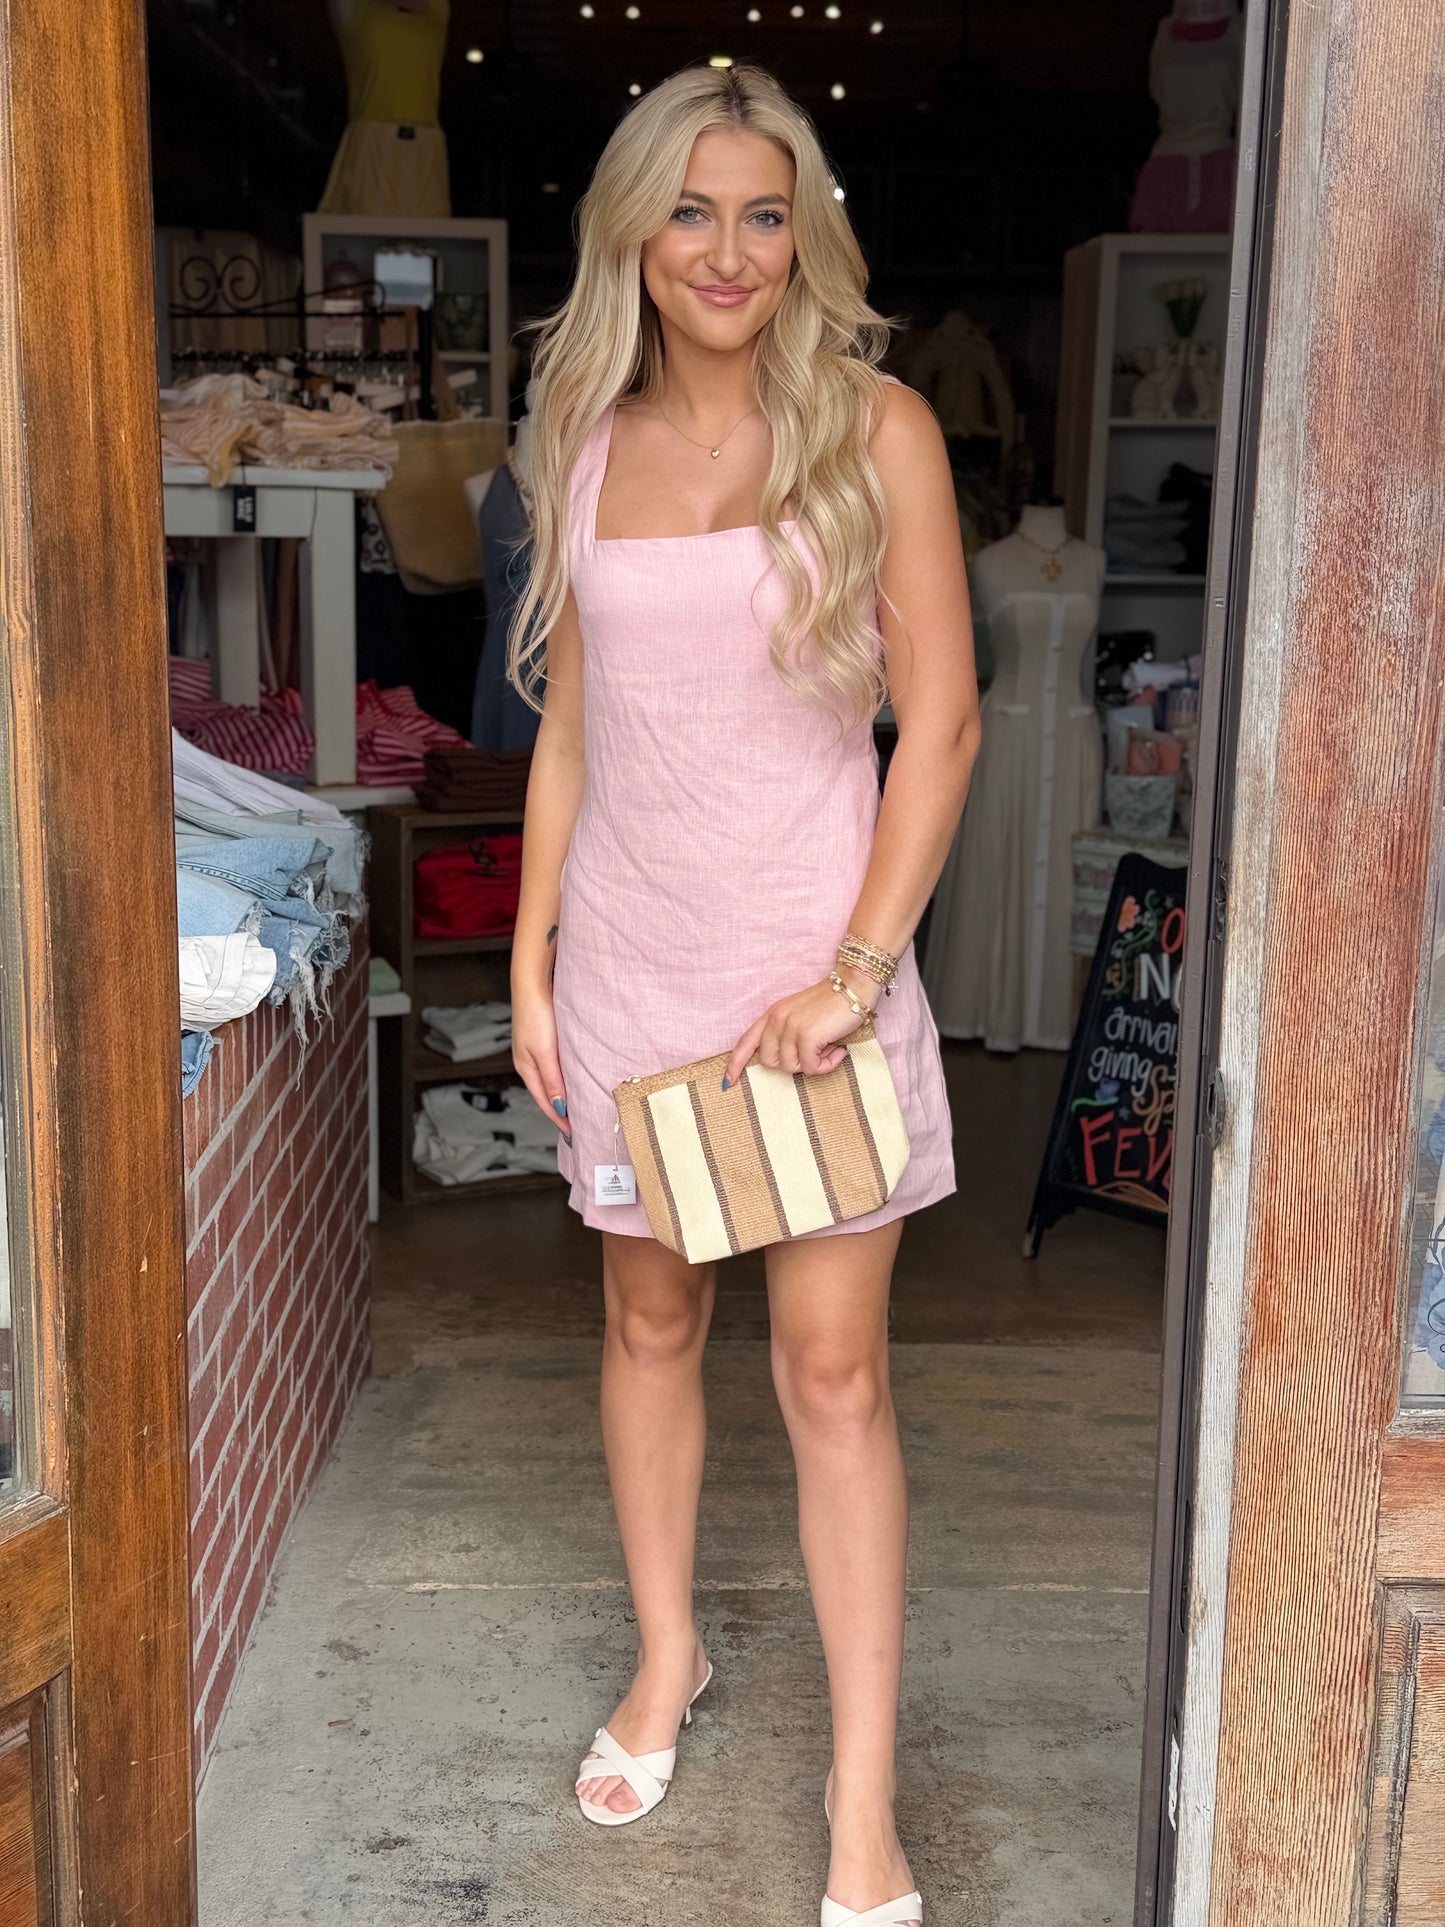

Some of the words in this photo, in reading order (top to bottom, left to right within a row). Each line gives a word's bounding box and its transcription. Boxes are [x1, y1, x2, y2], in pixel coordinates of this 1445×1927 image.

[1161, 907, 1185, 954] O
[1138, 952, 1184, 1012] N
[1104, 1006, 1178, 1057] arrival
[1087, 1045, 1154, 1098] giving
[1132, 1064, 1175, 1136] Sp
[1079, 1110, 1174, 1190] FEV
